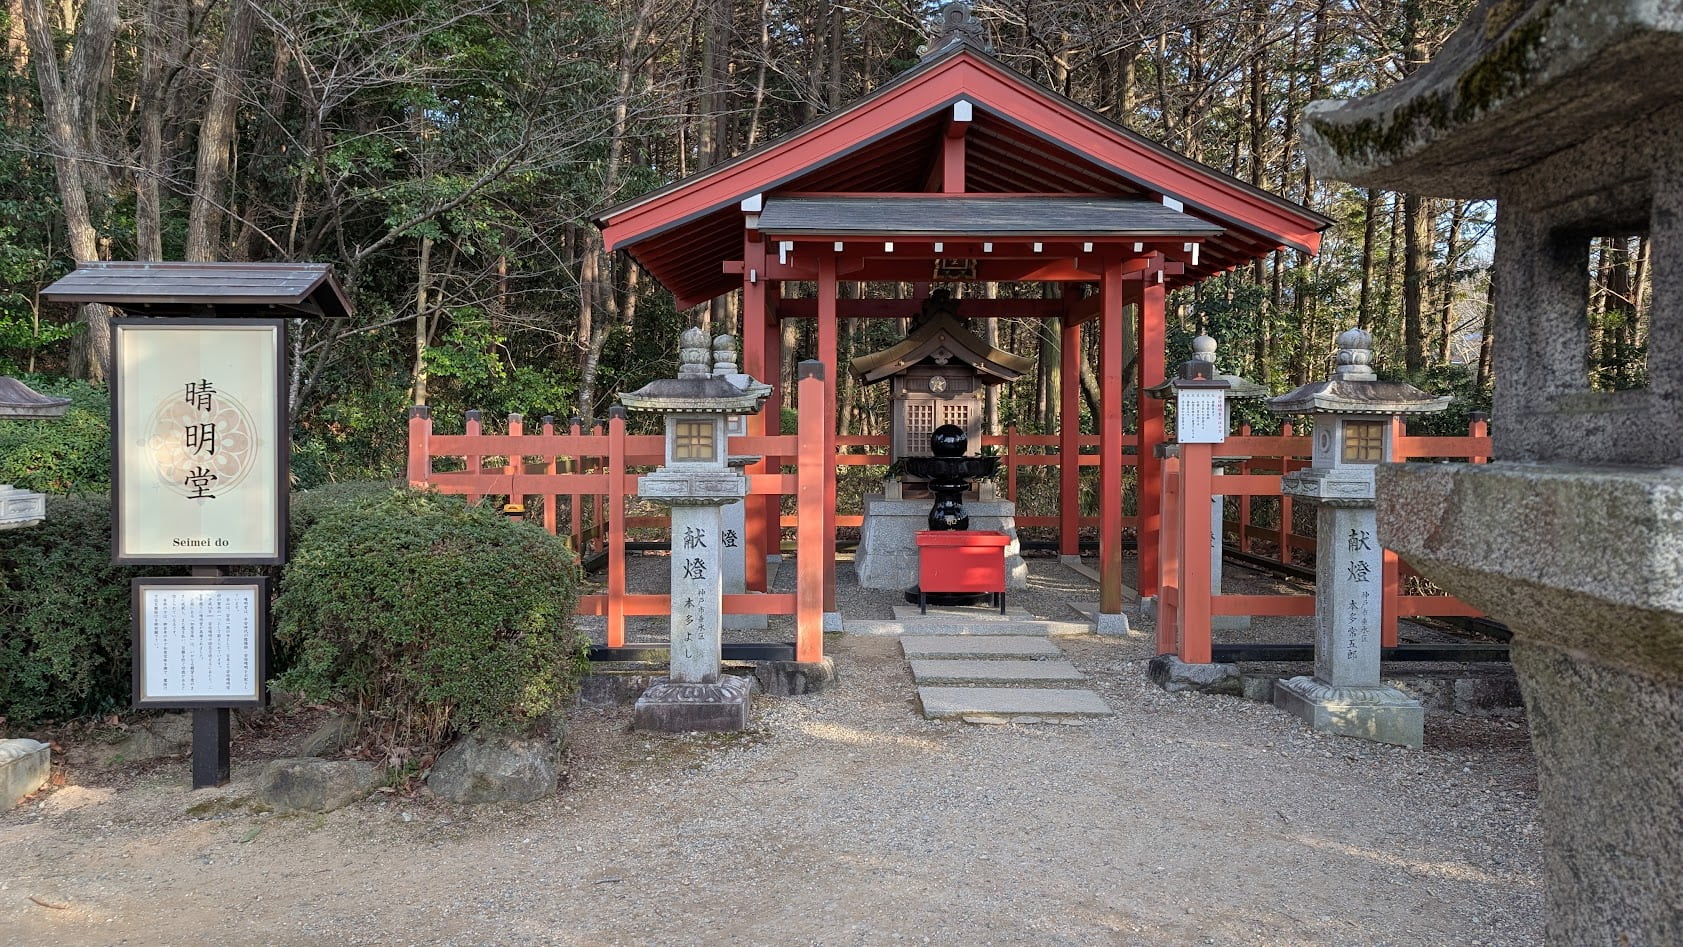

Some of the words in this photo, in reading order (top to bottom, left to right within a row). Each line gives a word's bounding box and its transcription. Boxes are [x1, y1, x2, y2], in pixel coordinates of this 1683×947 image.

[184, 378, 217, 499] 晴明堂
[172, 537, 211, 547] Seimei
[215, 537, 229, 547] do
[683, 526, 707, 580] 献燈
[1347, 528, 1372, 582] 献燈
